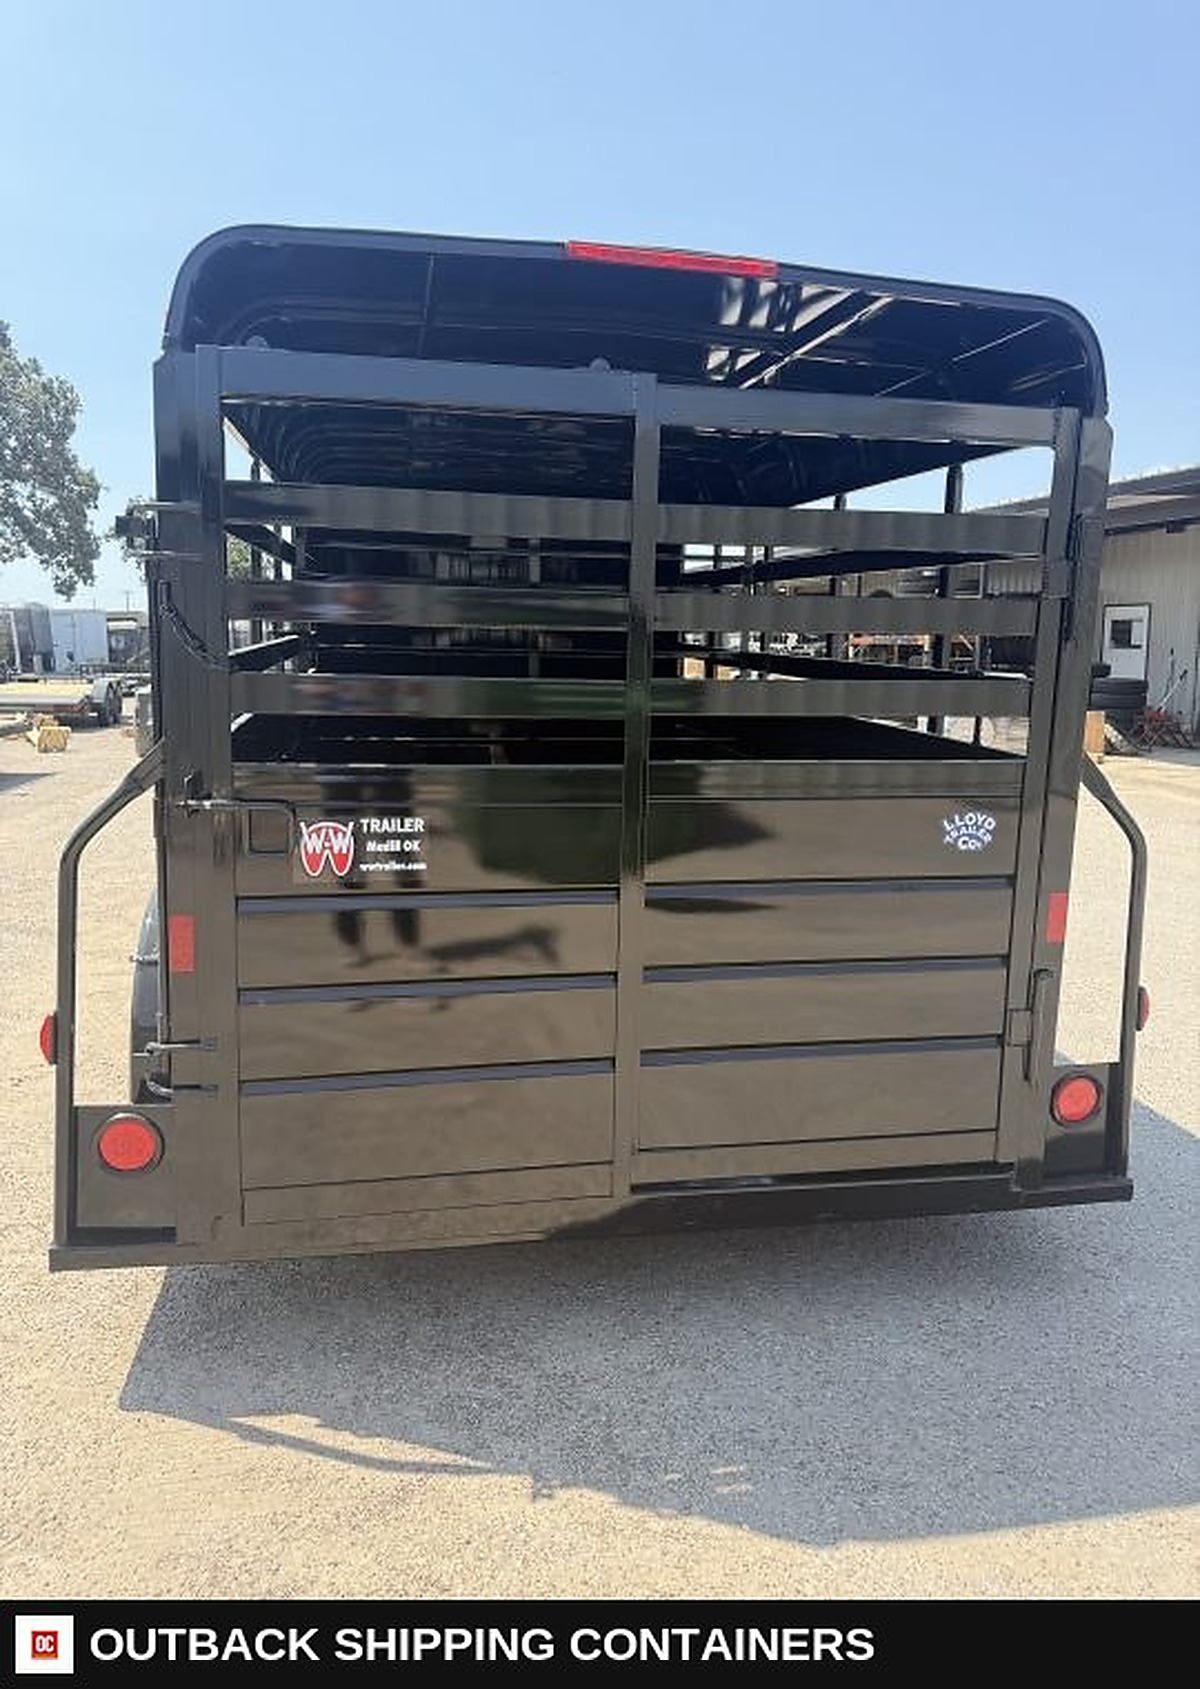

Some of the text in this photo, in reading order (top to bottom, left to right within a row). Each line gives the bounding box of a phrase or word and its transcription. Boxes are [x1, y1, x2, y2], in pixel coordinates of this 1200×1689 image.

[359, 817, 425, 834] TRAILER
[943, 812, 996, 831] LLOYD
[402, 839, 423, 853] OK
